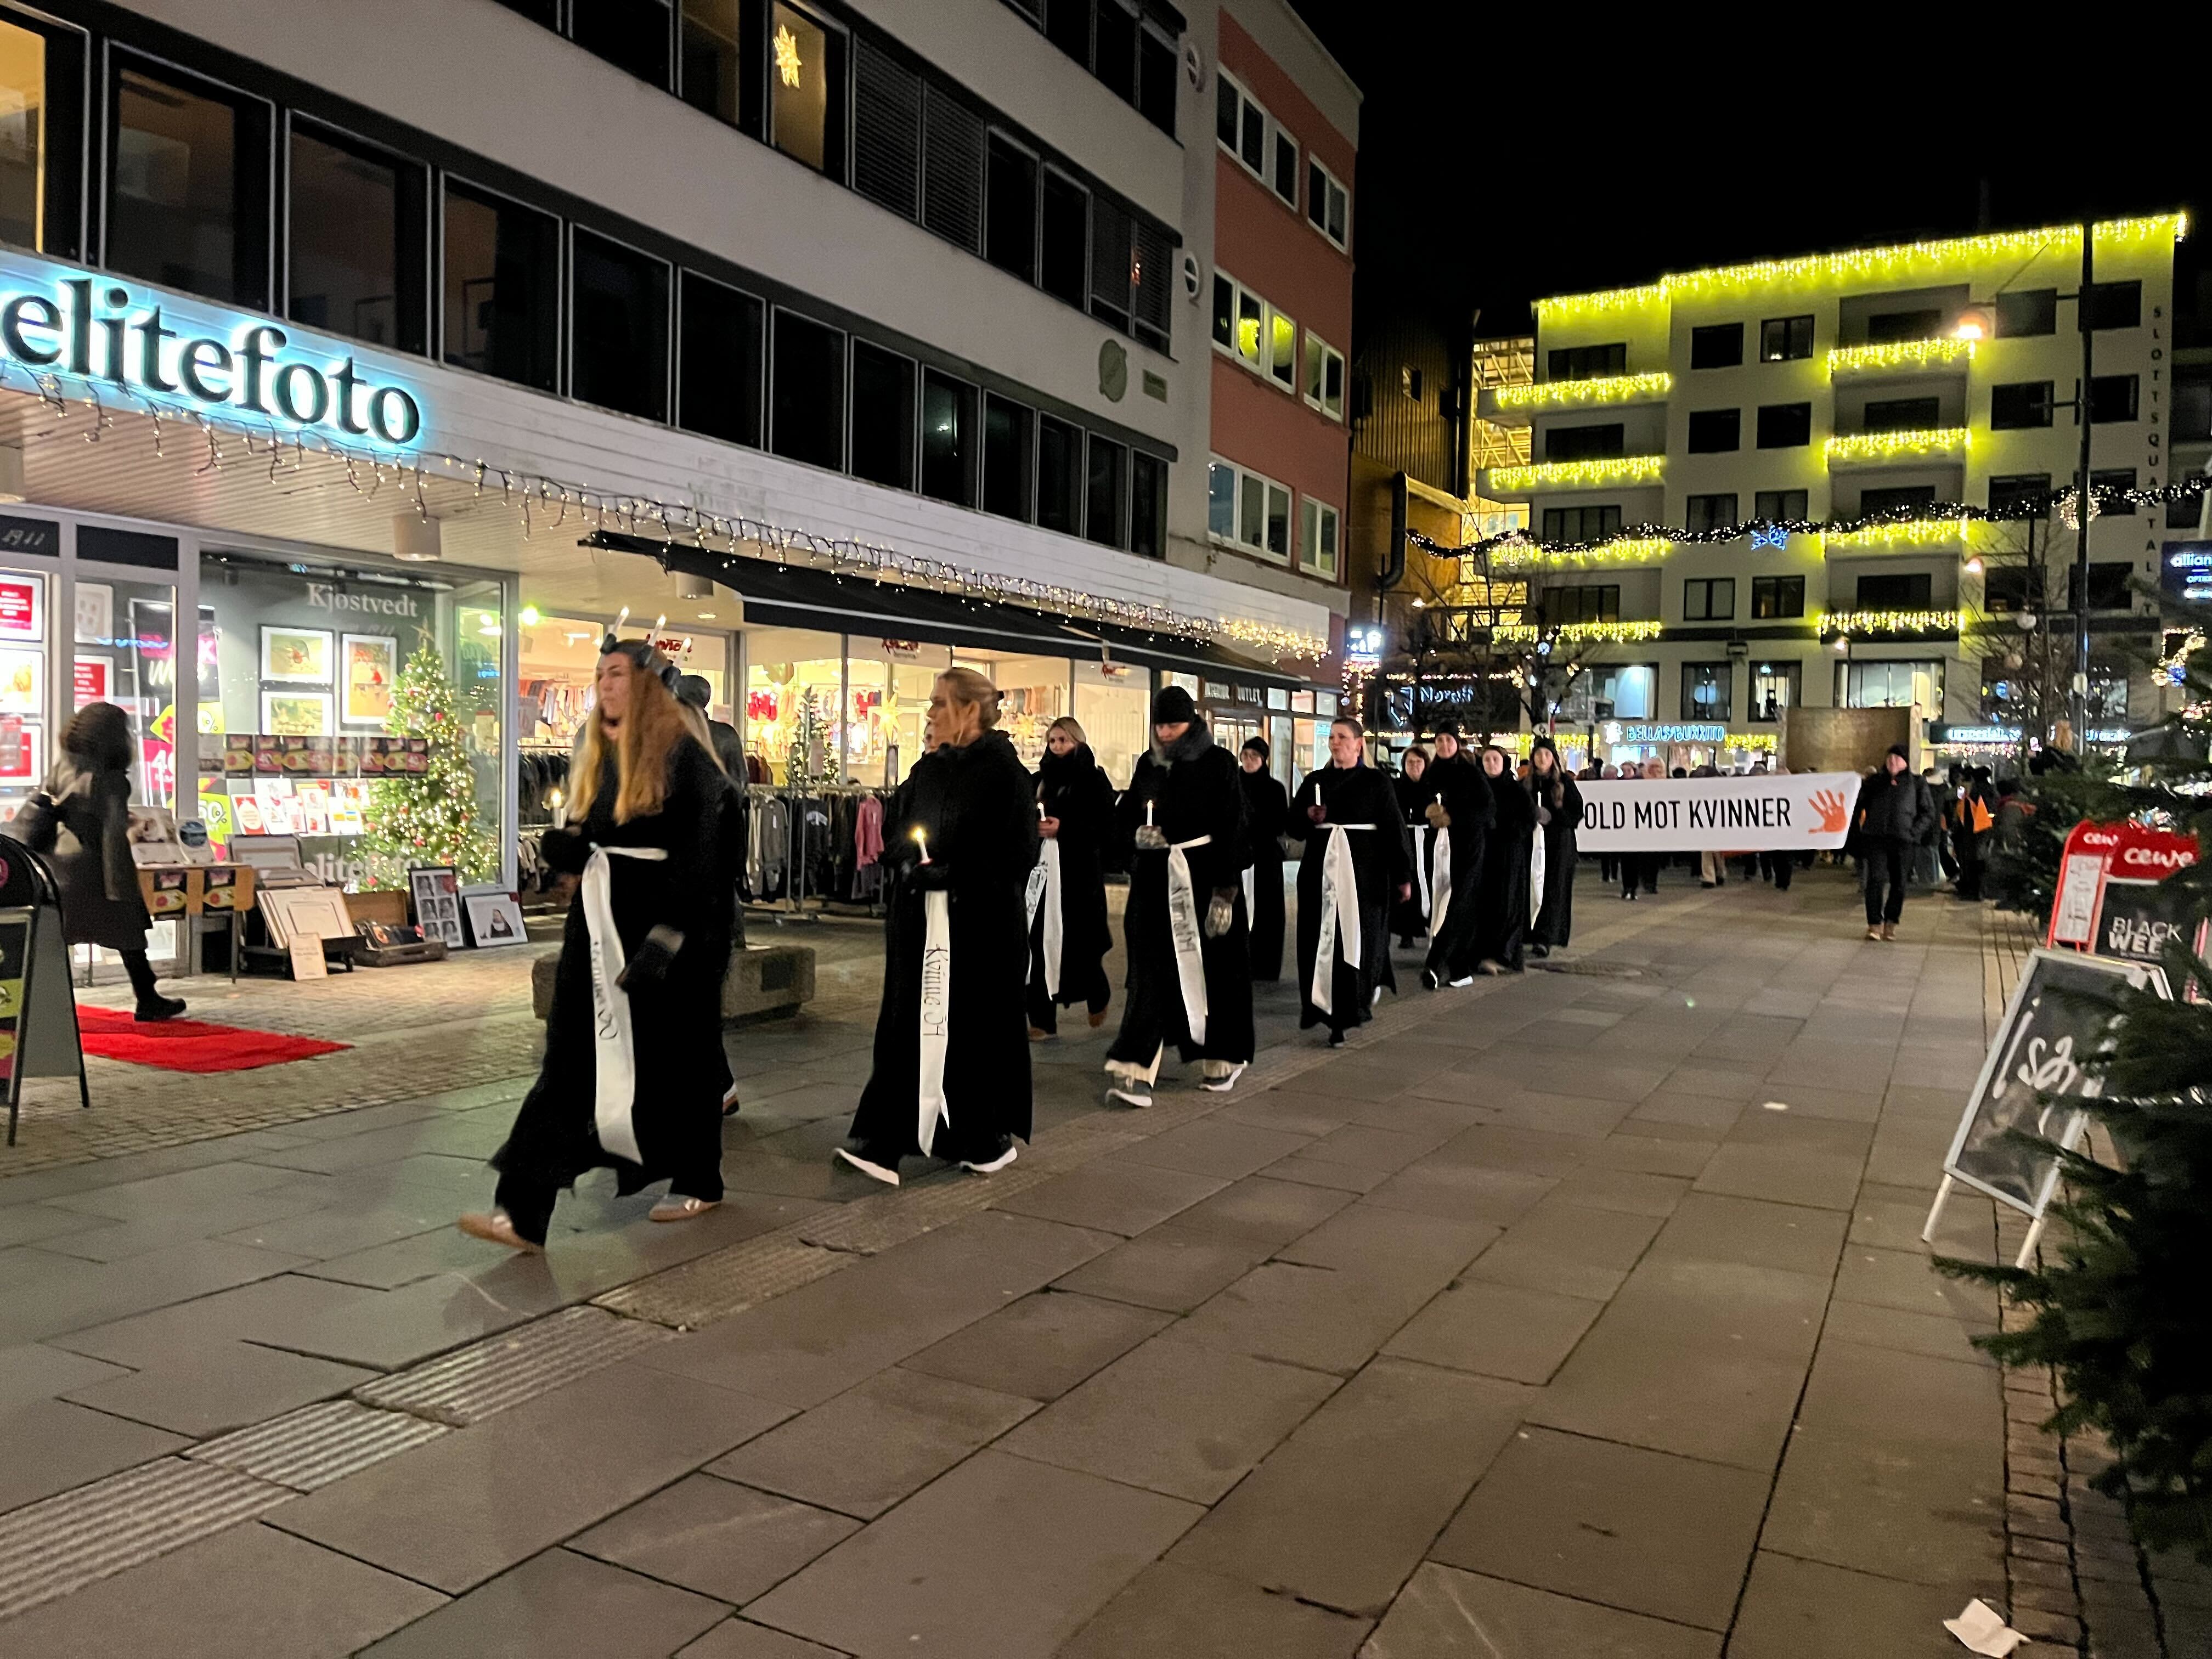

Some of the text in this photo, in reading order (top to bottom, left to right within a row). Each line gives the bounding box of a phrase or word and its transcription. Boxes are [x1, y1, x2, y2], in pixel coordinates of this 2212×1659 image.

[0, 278, 420, 444] elitefoto
[2142, 306, 2163, 614] SLOTTSQUATALT
[1672, 725, 1724, 742] BURRITO
[1583, 798, 1792, 830] OLD MOT KVINNER
[2083, 832, 2118, 847] cew
[2124, 847, 2194, 868] cewe
[2112, 916, 2182, 942] BLACK
[2108, 930, 2163, 955] WEE
